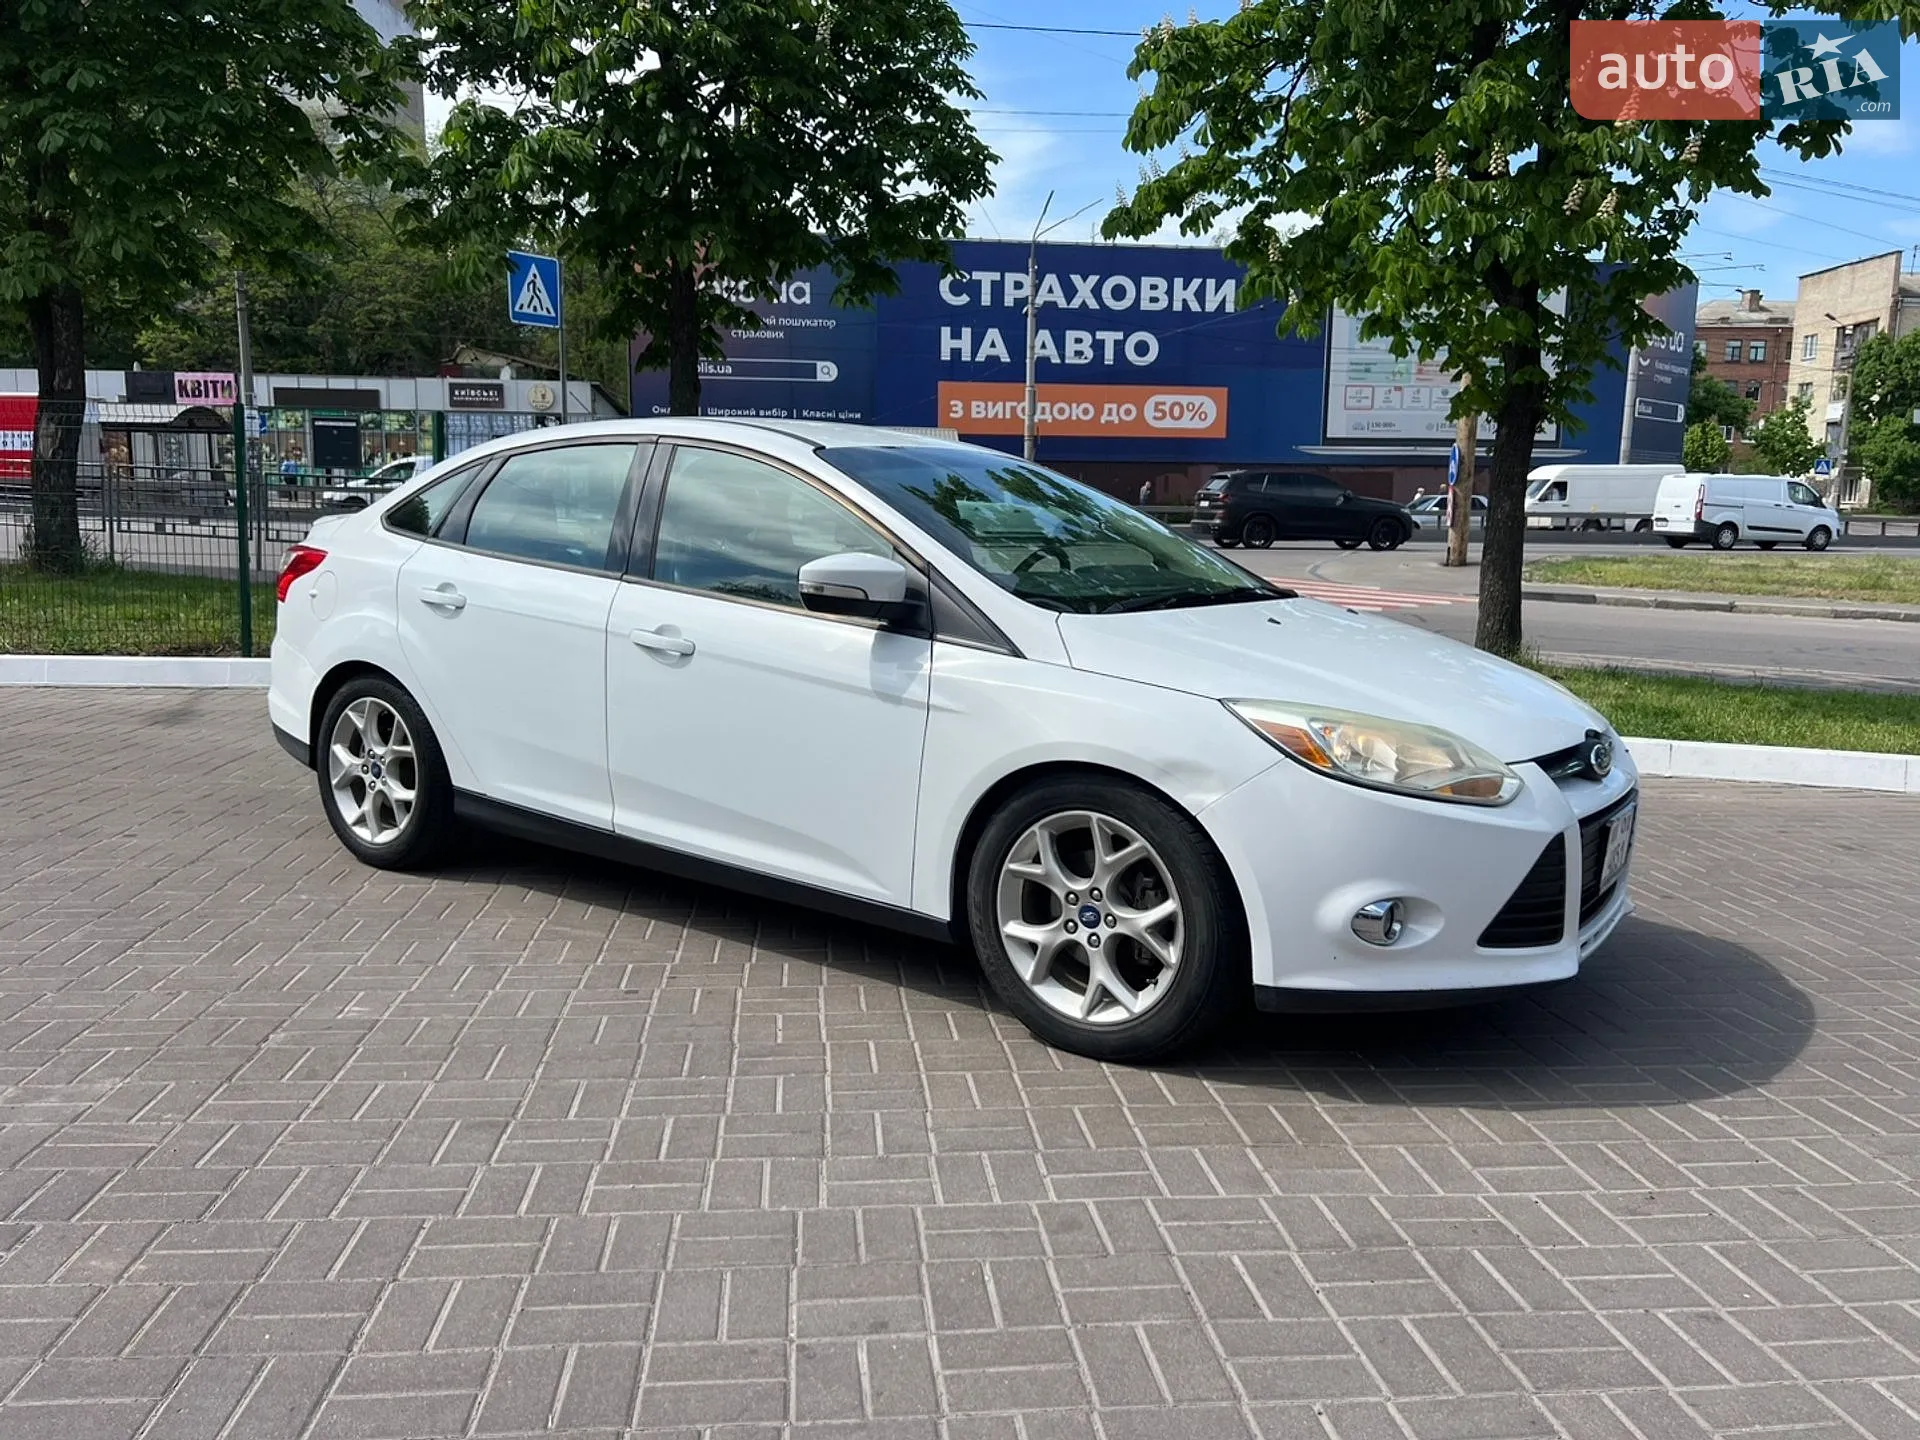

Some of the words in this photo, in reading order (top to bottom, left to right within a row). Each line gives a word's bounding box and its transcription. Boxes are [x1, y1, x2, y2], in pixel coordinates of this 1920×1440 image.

[938, 270, 1237, 313] СТРАХОВКИ
[940, 326, 1011, 363] НА
[1033, 328, 1159, 367] АВТО
[177, 377, 233, 400] КВІТИ
[707, 406, 756, 418] Широкий
[759, 407, 788, 418] вибір
[803, 408, 836, 419] Класні
[839, 409, 862, 421] ціни
[1152, 400, 1208, 422] 50%
